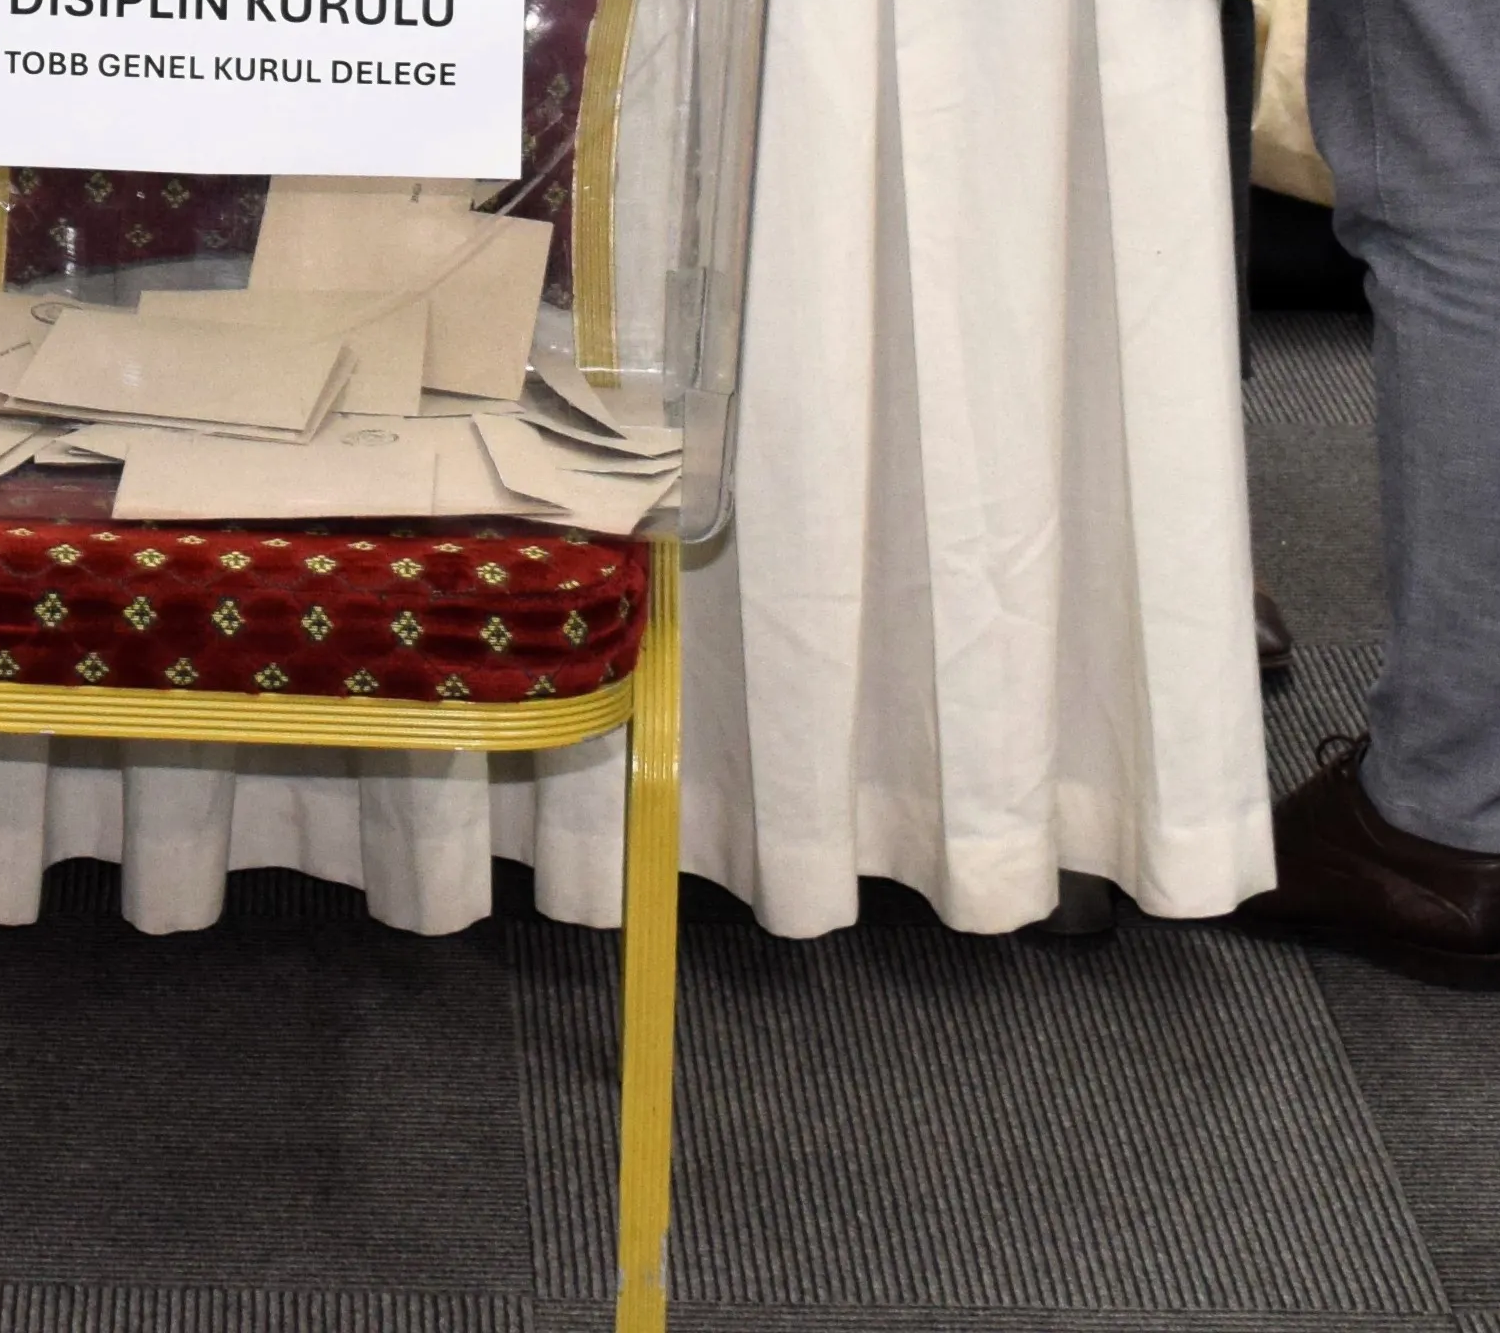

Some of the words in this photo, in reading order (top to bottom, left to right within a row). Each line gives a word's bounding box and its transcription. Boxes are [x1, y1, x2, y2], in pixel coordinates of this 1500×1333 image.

[3, 49, 90, 77] TOBB
[97, 52, 206, 81] GENEL
[213, 55, 323, 84] KURUL
[330, 59, 457, 87] DELEGE
